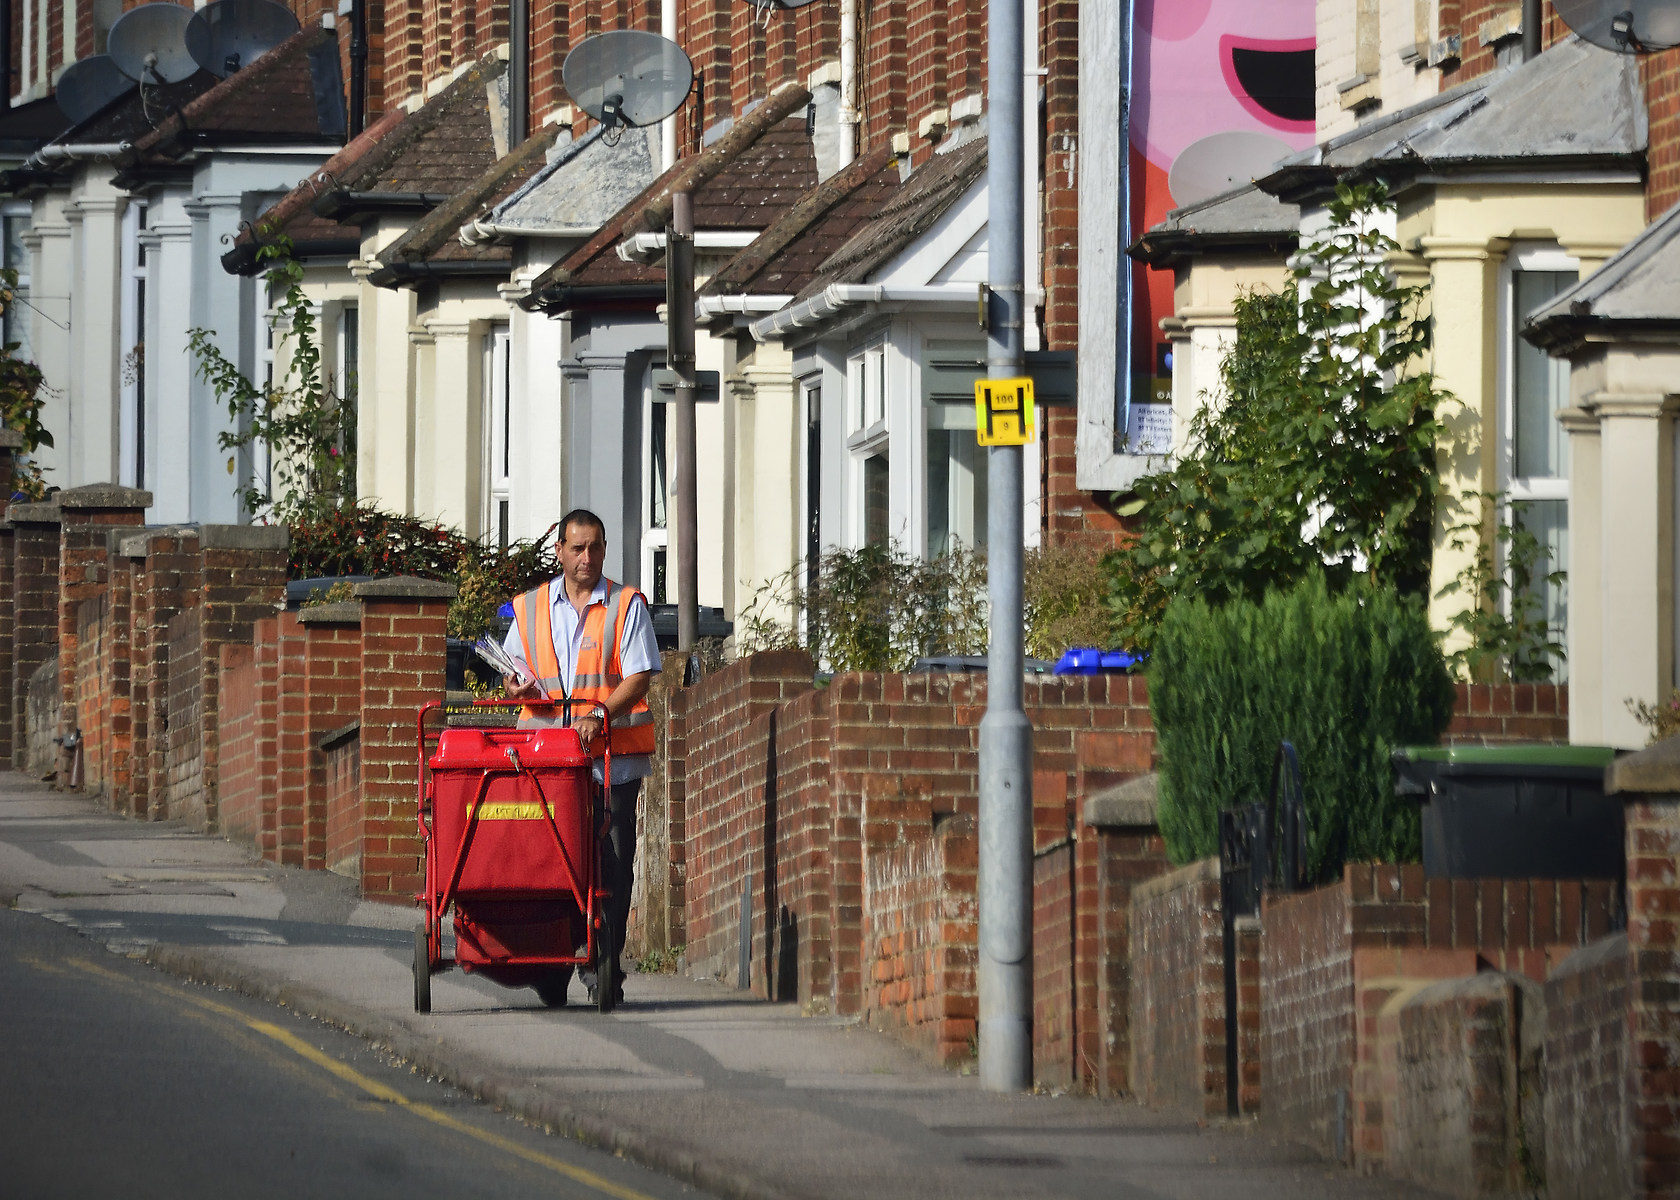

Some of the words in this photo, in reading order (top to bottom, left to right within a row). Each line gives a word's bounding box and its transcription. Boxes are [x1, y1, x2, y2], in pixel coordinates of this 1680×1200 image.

[996, 395, 1014, 404] 100
[984, 387, 1026, 438] H
[1003, 422, 1009, 430] 9
